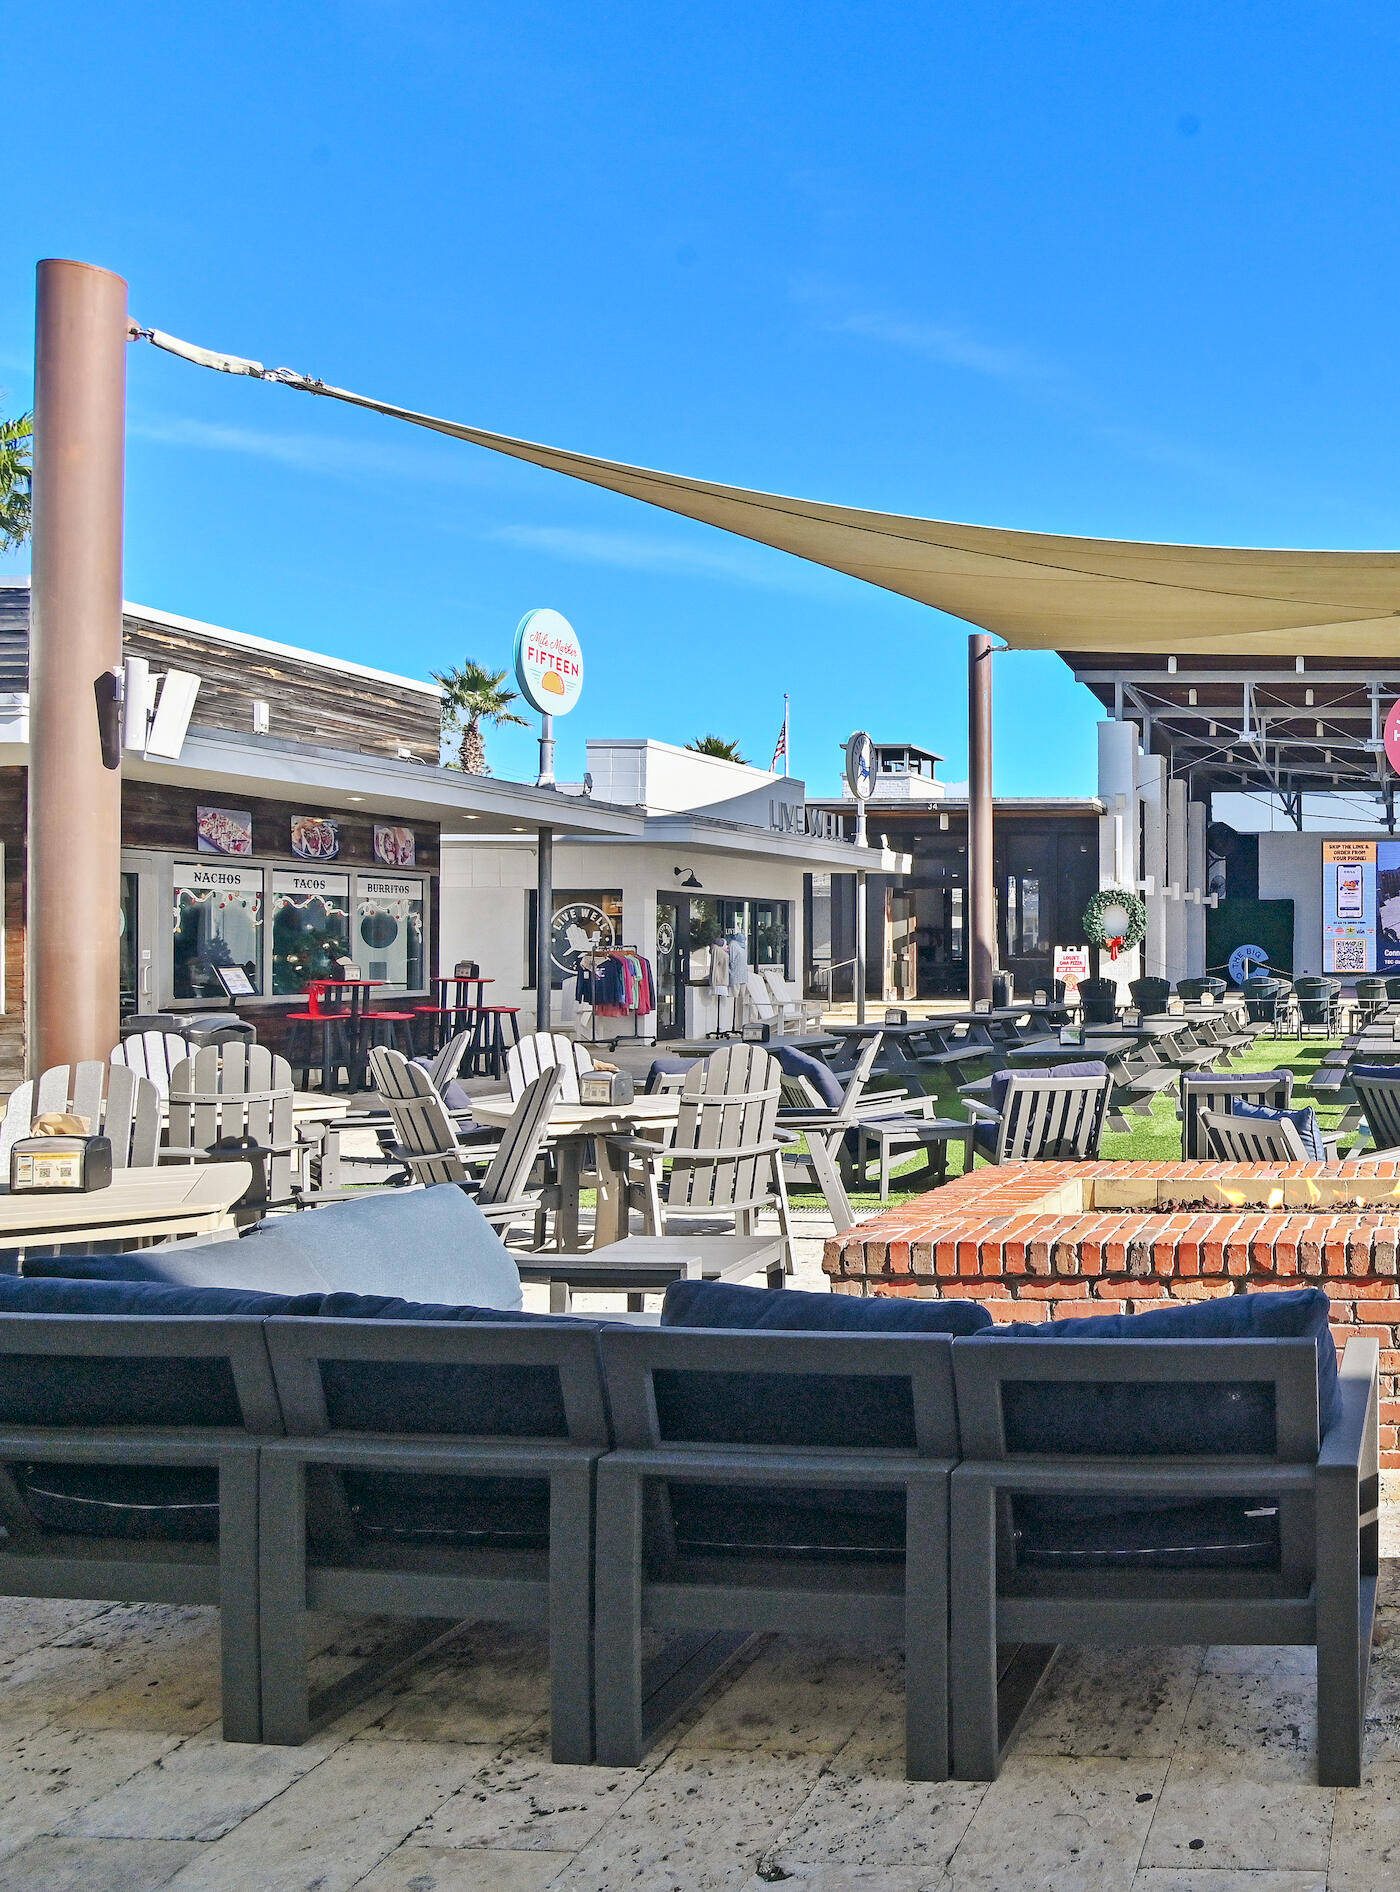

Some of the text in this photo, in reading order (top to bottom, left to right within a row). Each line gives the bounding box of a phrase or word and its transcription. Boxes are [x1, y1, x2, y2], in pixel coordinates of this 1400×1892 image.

[529, 631, 578, 658] Mile Marker
[527, 646, 579, 677] FIFTEEN
[927, 802, 938, 810] 34
[768, 799, 848, 842] LIVE WELL
[193, 871, 241, 885] NACHOS
[293, 878, 326, 889] TACOS
[367, 883, 410, 894] BURRITOS
[552, 908, 609, 931] LIVE WELL
[1232, 948, 1262, 968] THE BIG
